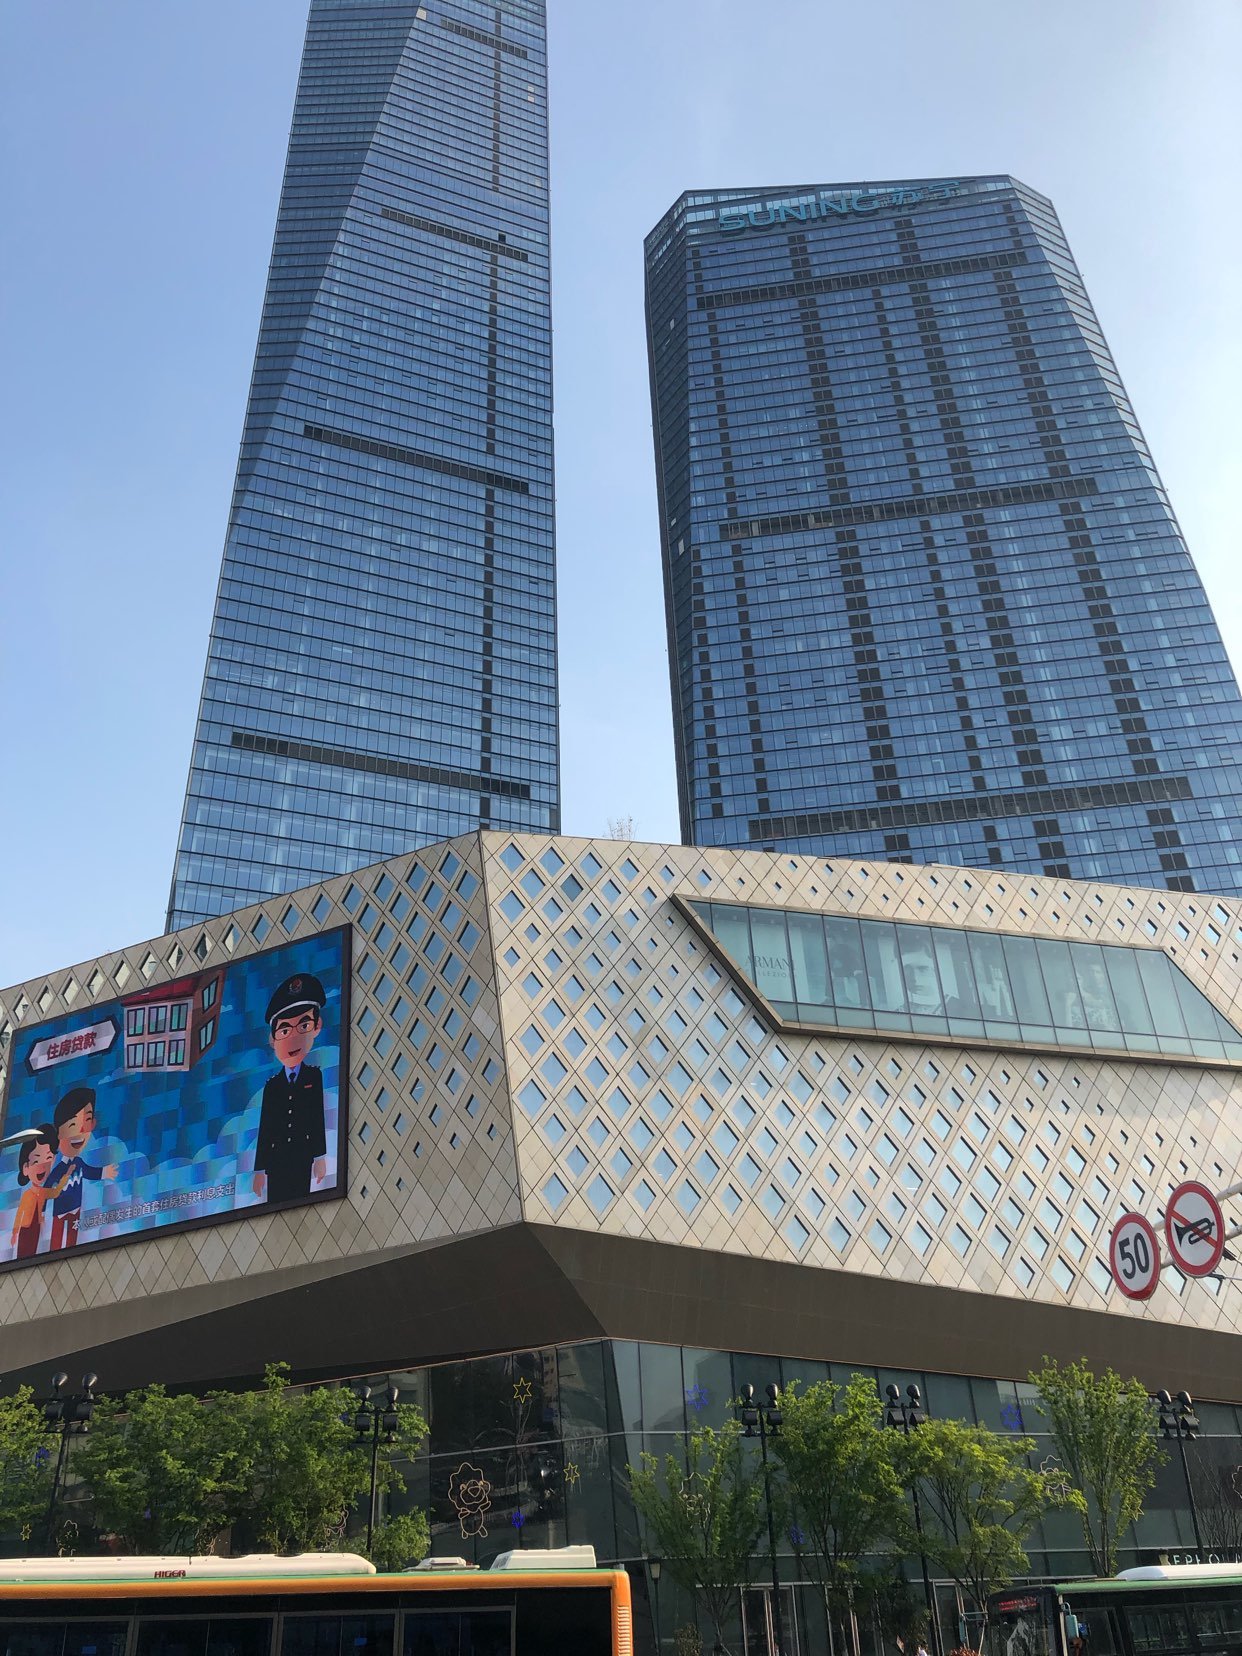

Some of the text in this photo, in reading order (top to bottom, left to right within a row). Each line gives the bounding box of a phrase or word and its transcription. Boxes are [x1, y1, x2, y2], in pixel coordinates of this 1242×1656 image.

[718, 192, 880, 231] SUNING
[46, 1031, 97, 1060] 住房贷款
[1118, 1232, 1150, 1280] 50
[154, 1570, 186, 1578] HIGER
